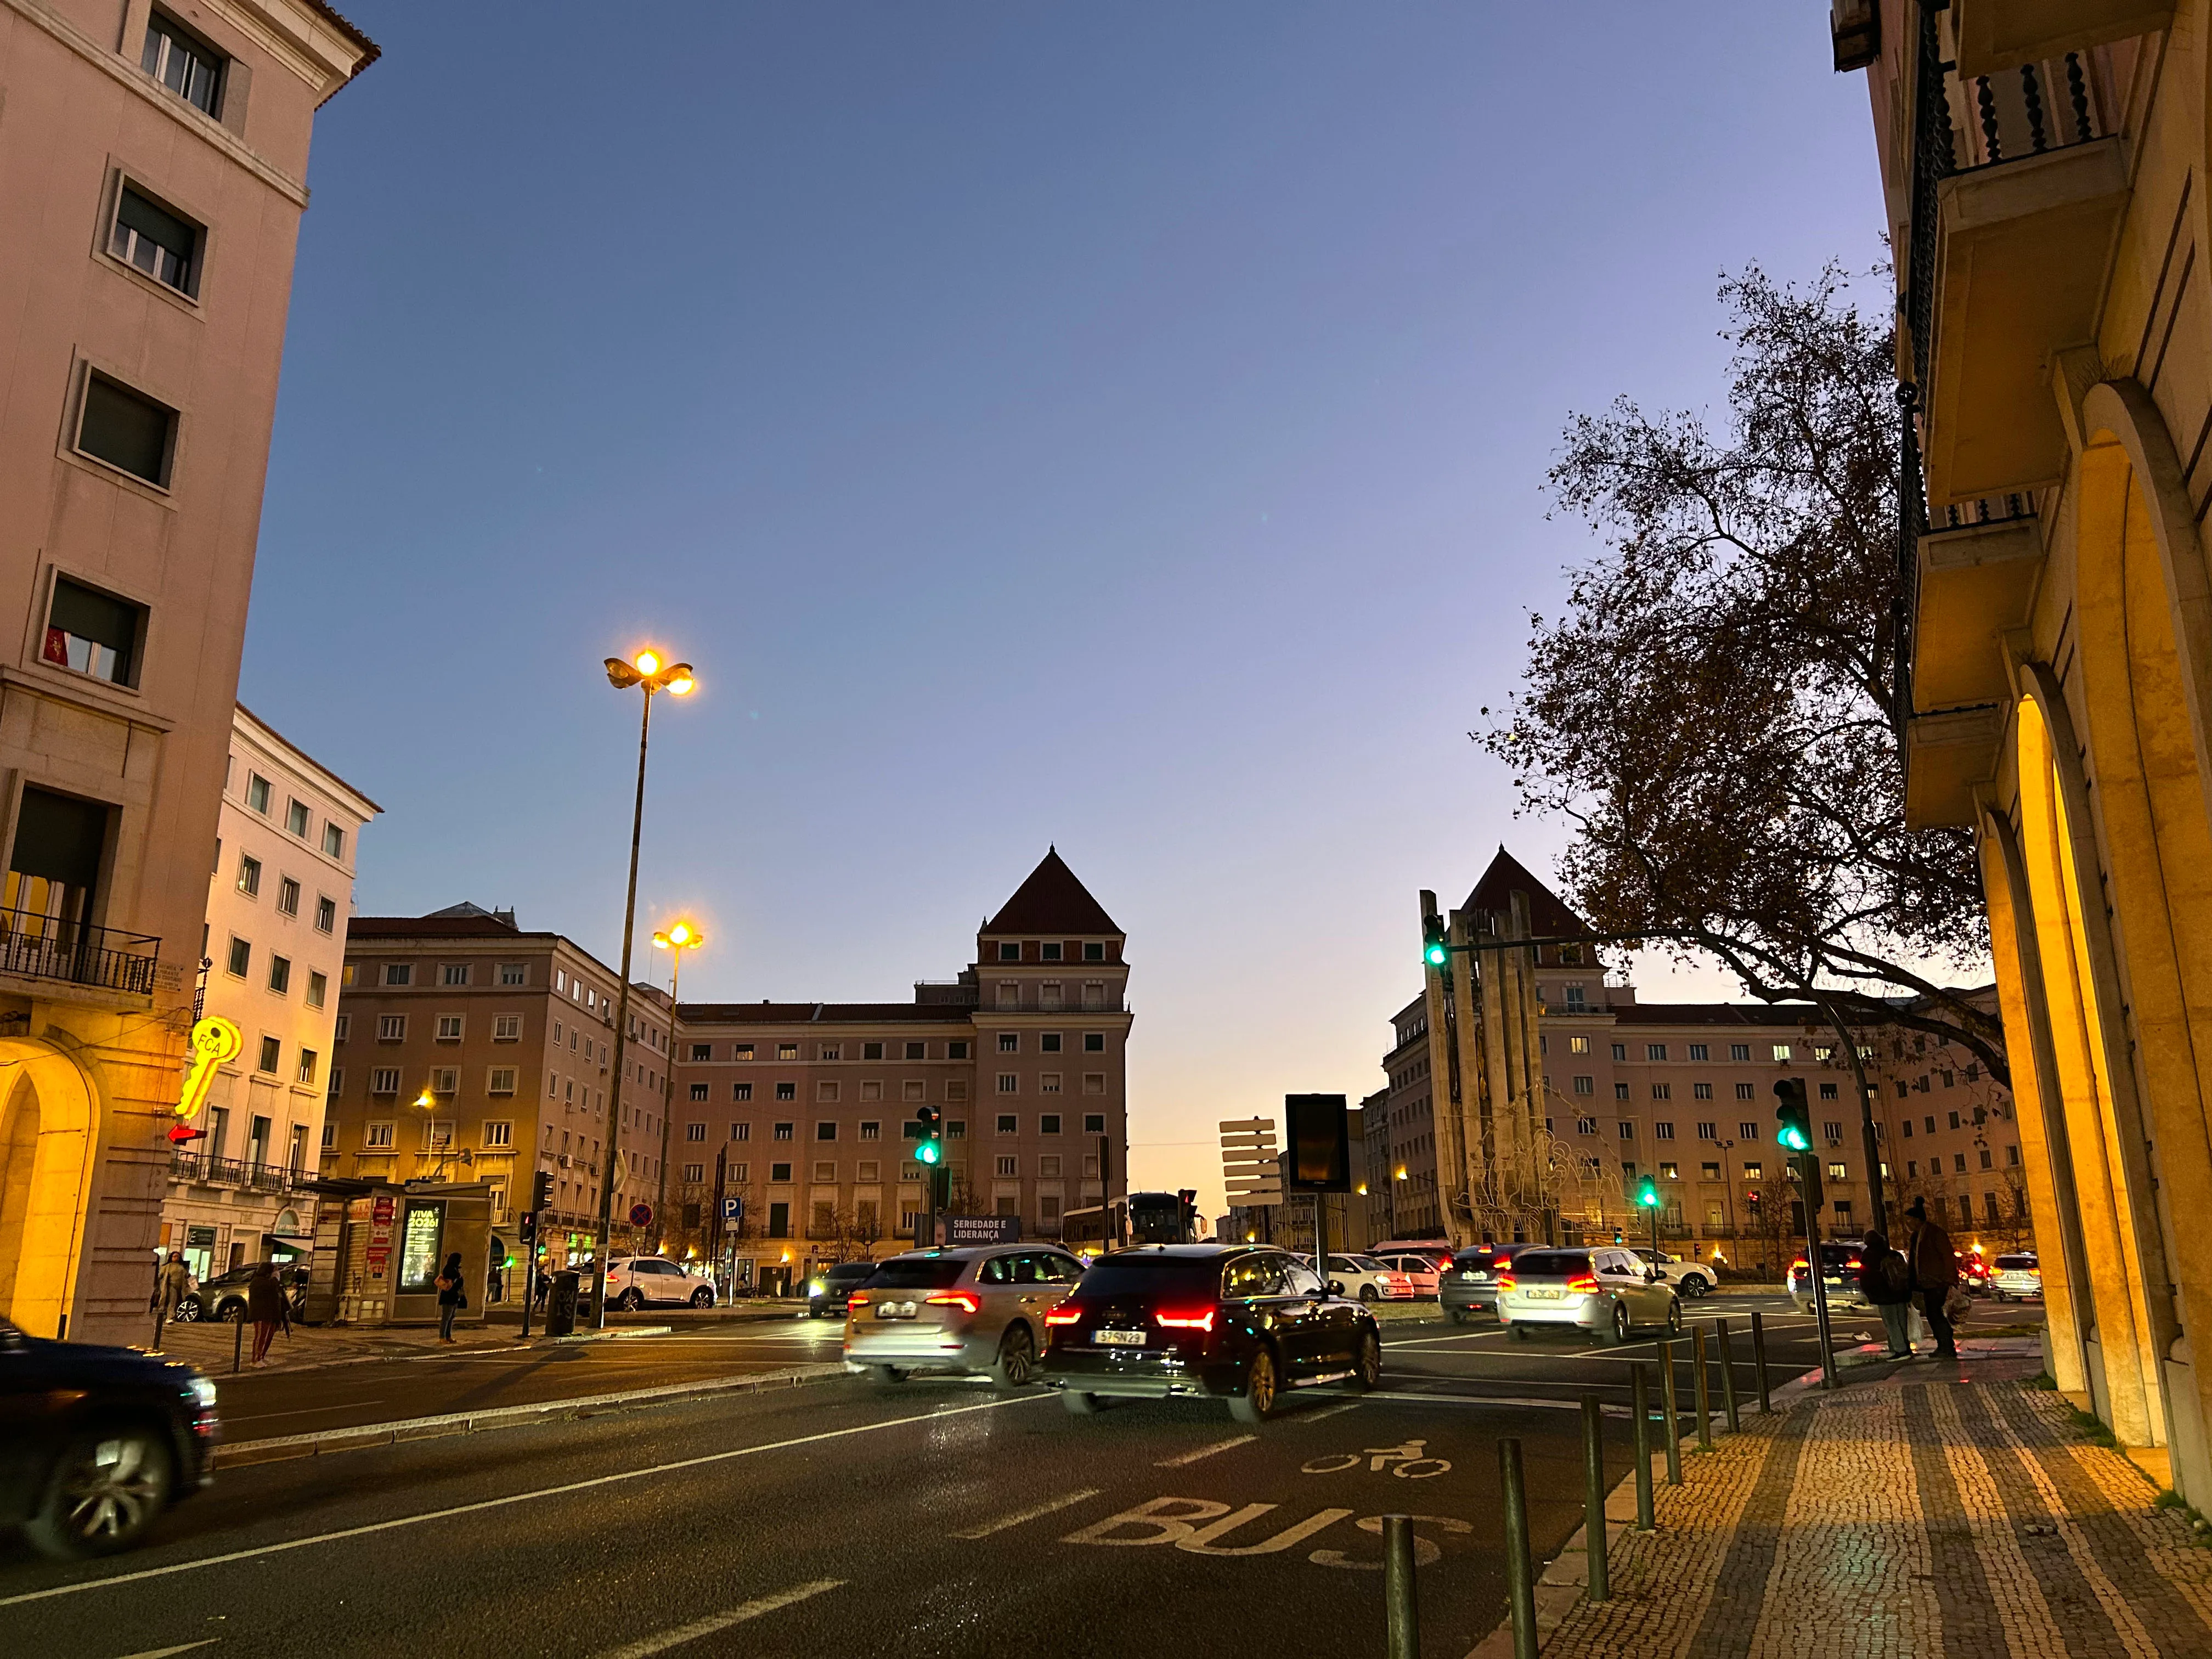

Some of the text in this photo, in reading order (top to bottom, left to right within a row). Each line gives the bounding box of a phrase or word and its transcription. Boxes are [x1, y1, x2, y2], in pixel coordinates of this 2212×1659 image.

[198, 1034, 221, 1057] FCA
[725, 1199, 737, 1216] P
[410, 1210, 434, 1218] VIVA
[408, 1217, 439, 1227] 2026!
[953, 1220, 1006, 1229] SERIEDADE E
[953, 1229, 999, 1241] LIDERANÇA
[1059, 1496, 1474, 1570] BUS
